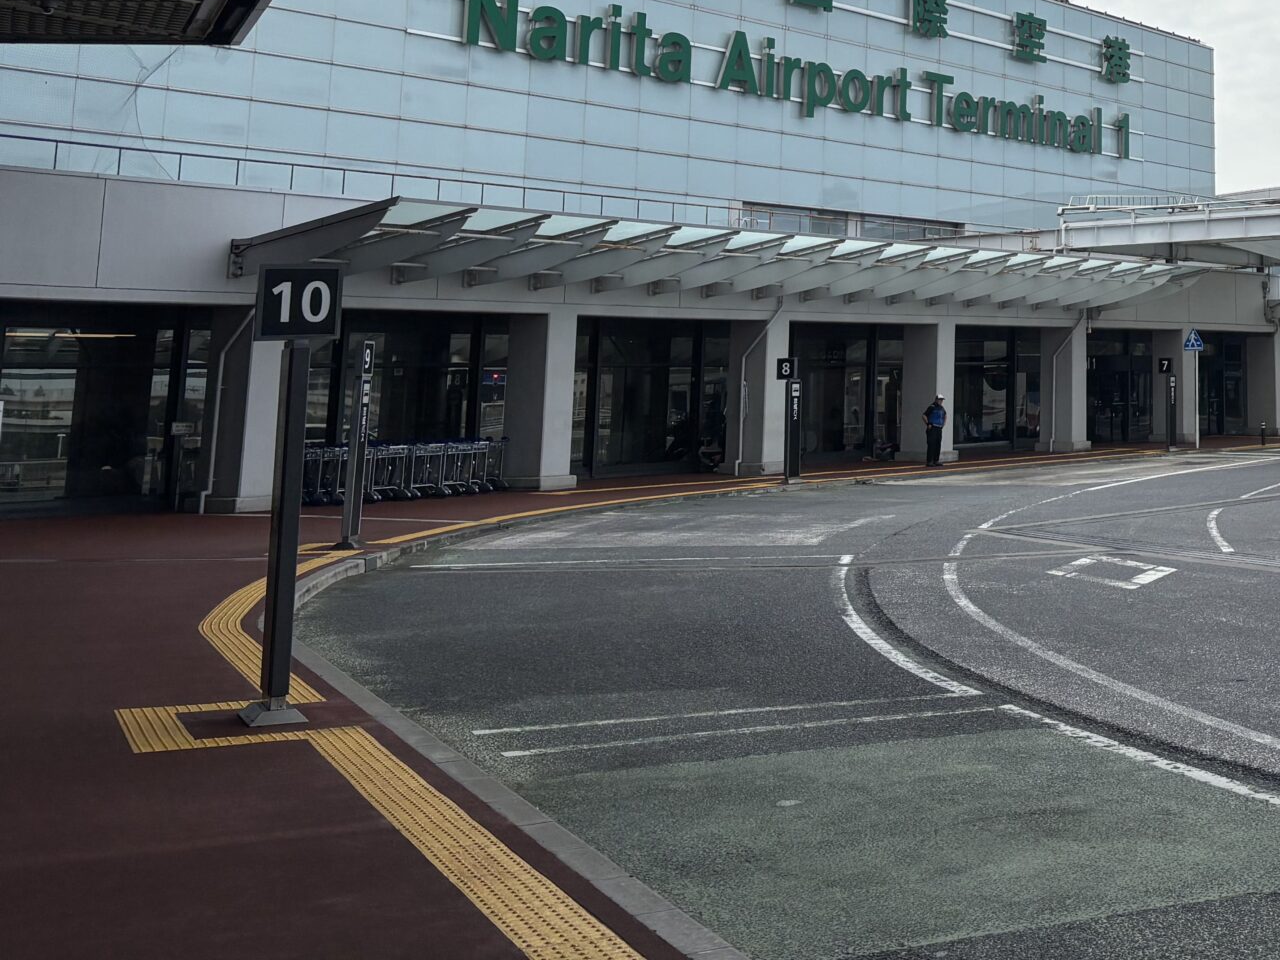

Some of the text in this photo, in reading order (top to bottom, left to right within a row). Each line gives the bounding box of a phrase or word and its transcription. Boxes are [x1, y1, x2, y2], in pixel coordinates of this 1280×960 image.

[715, 30, 912, 119] Airport
[924, 70, 1102, 155] Terminal
[1116, 113, 1131, 160] 1
[271, 280, 332, 324] 10
[364, 349, 371, 369] 9
[781, 362, 790, 375] 8
[1161, 360, 1168, 371] 7
